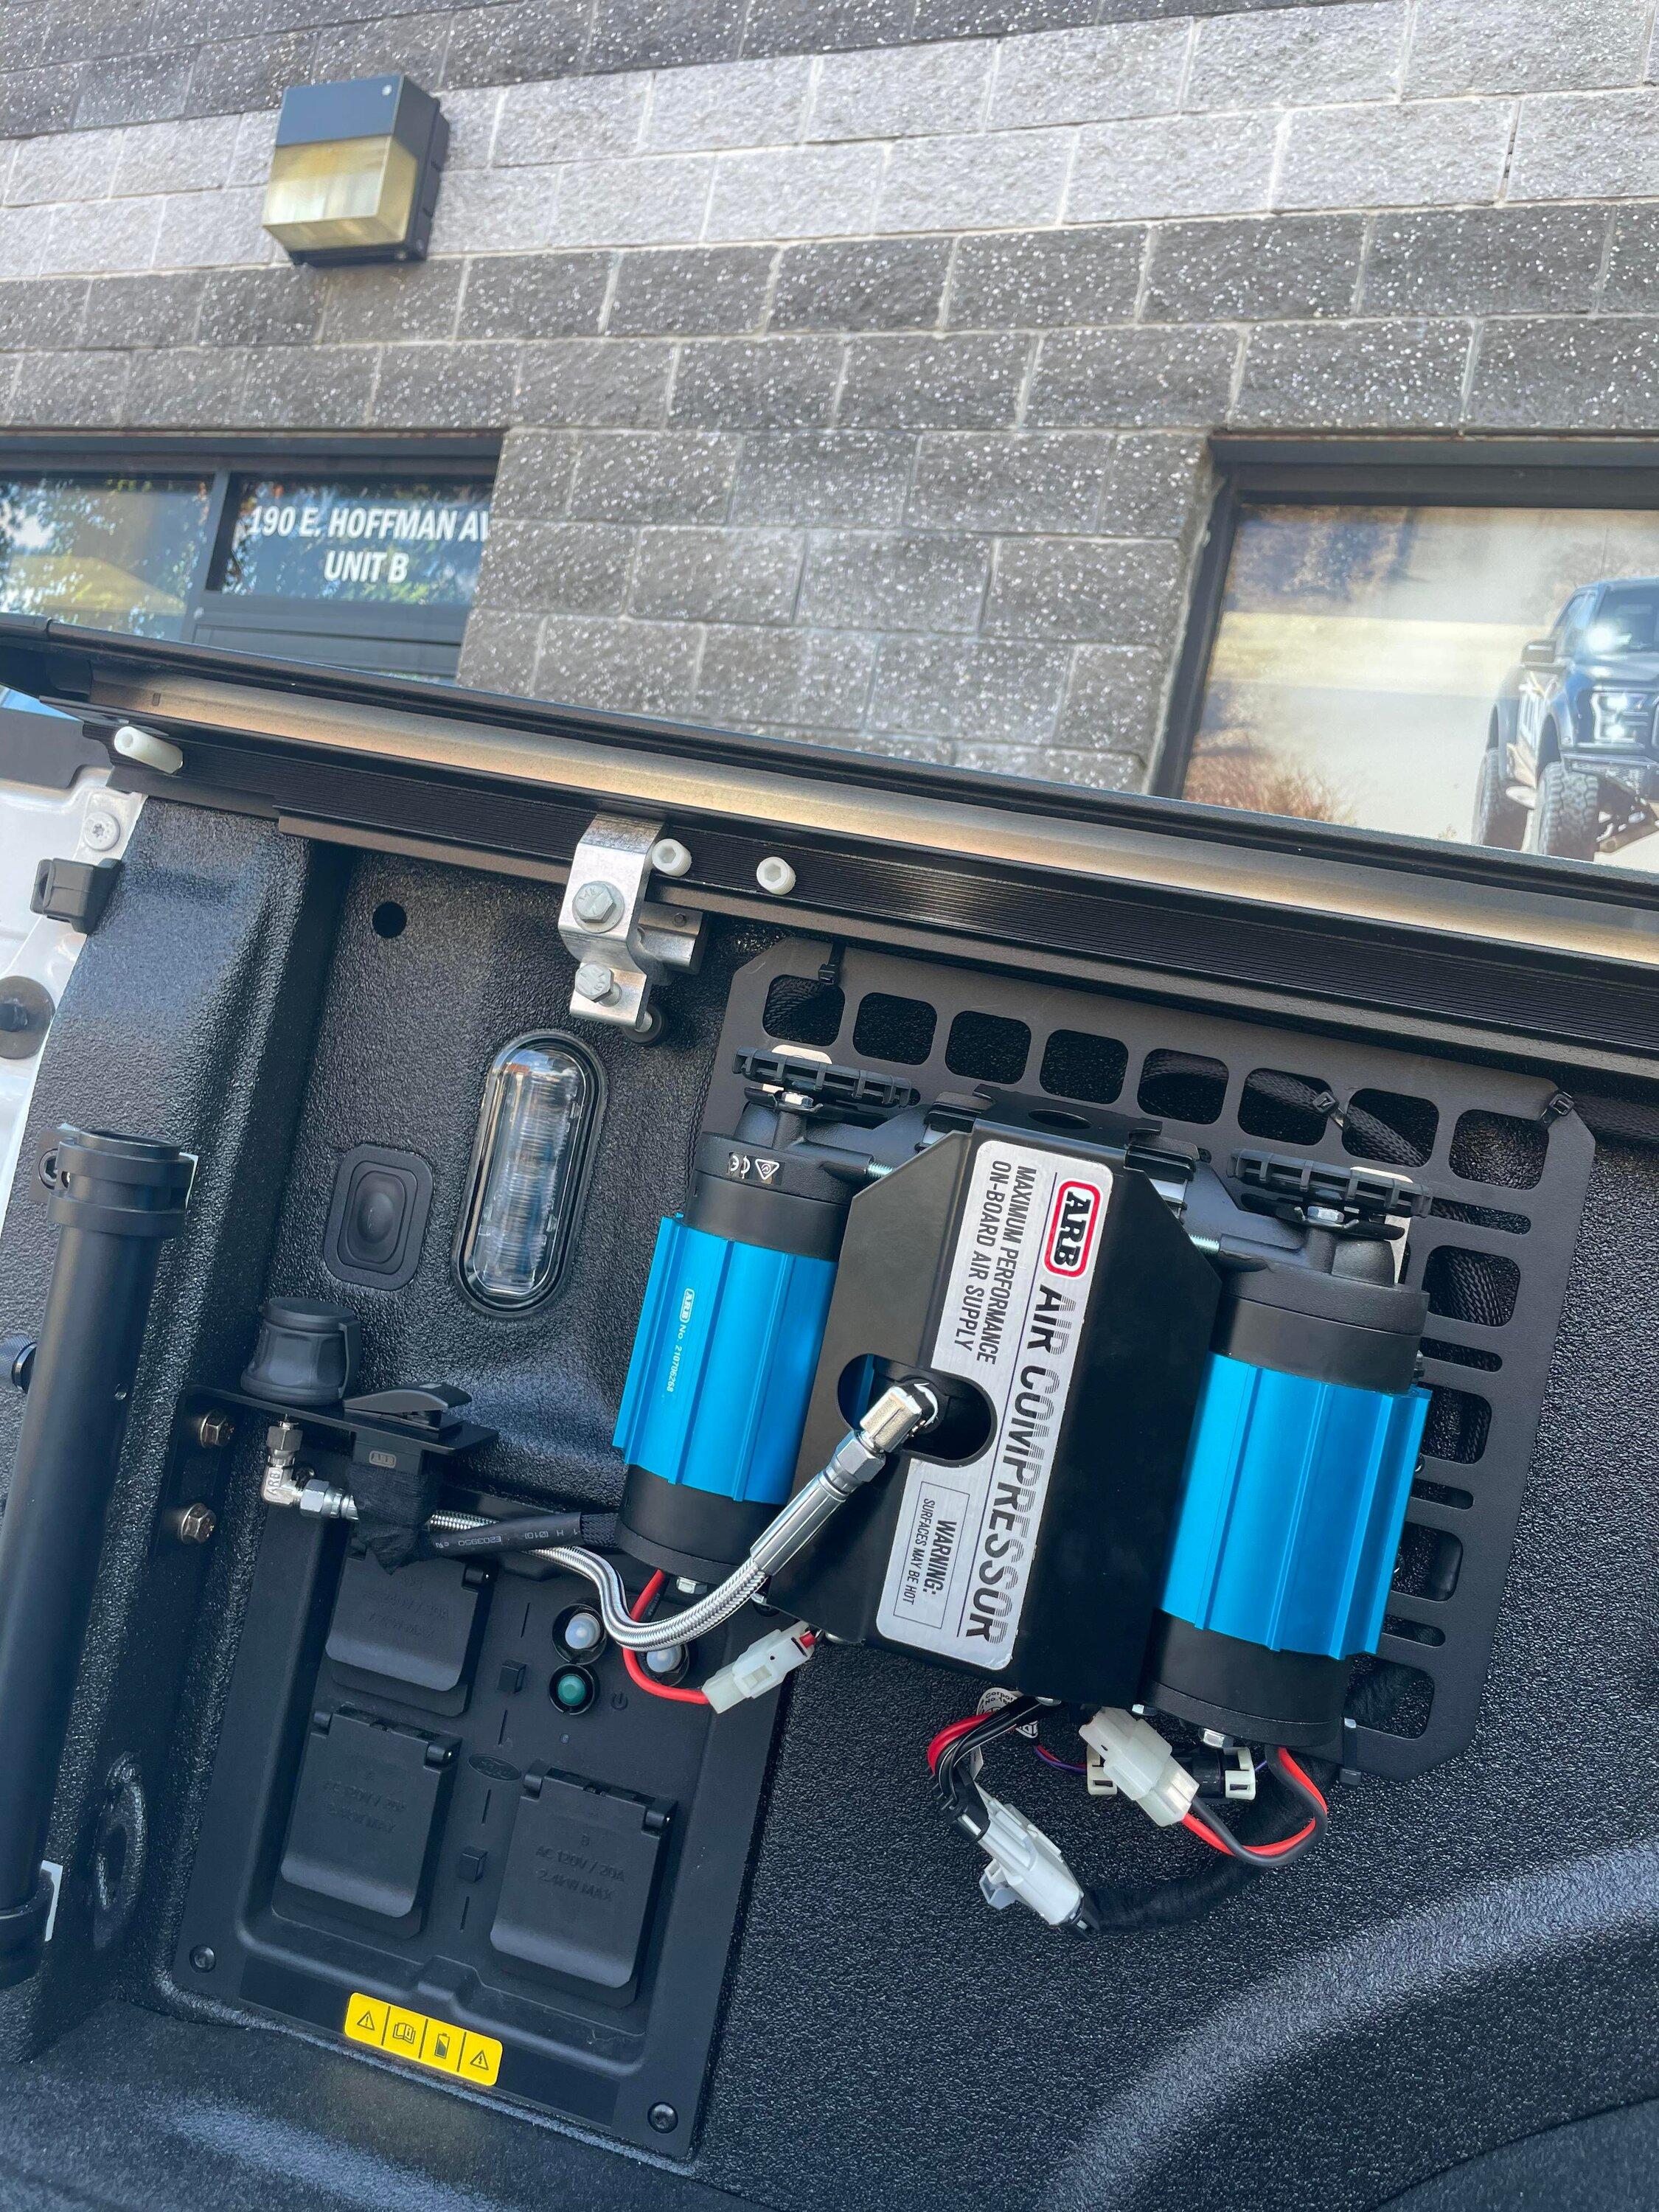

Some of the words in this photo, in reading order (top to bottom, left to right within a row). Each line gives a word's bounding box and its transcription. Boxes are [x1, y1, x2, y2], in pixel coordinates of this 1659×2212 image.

[248, 506, 296, 537] 190
[300, 507, 321, 538] E.
[329, 508, 457, 541] HOFFMAN
[324, 549, 385, 582] UNIT
[388, 553, 409, 583] B
[976, 1160, 1012, 1247] ON-BOARD
[1003, 1166, 1037, 1244] MAXIMUM
[1054, 1192, 1092, 1267] ARB
[969, 1251, 992, 1281] AIR
[954, 1285, 985, 1352] SUPPLY
[976, 1247, 1020, 1365] PERFORMANCE
[1027, 1284, 1077, 1354] AIR
[676, 1324, 687, 1342] No.
[266, 1472, 280, 1495] ARB
[915, 1498, 936, 1546] SURFACES
[965, 1366, 1060, 1644] COMPRESSOR
[907, 1570, 920, 1585] BE
[911, 1547, 925, 1569] MAY
[922, 1520, 957, 1595] WARNING:
[902, 1586, 918, 1605] HOT
[535, 1846, 553, 1858] AC
[556, 1850, 588, 1869] 120V
